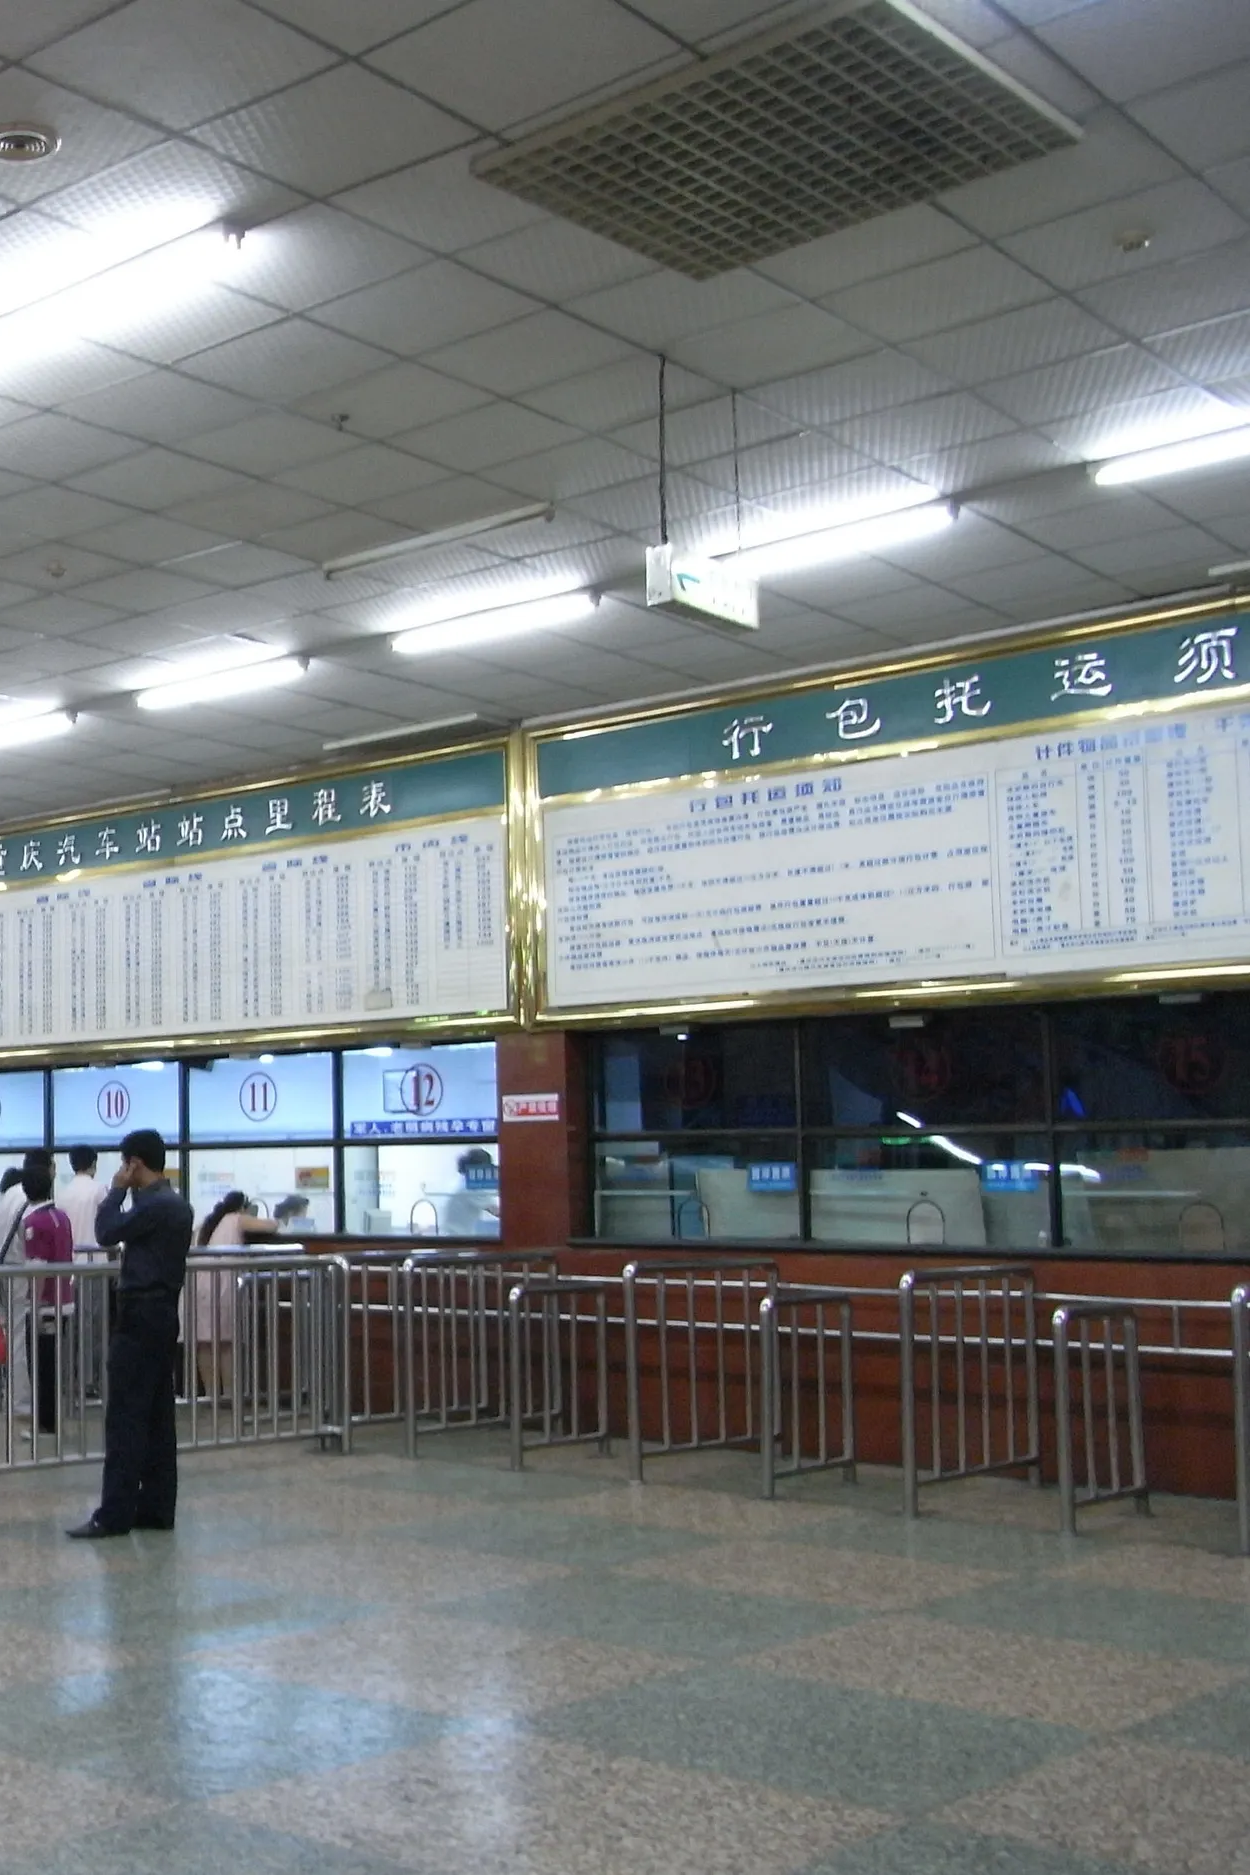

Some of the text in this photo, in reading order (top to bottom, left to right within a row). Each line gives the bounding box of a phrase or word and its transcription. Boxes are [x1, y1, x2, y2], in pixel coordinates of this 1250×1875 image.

[722, 627, 1238, 761] 行包托运须
[105, 1090, 125, 1120] 10
[248, 1079, 271, 1112] 11
[412, 1074, 435, 1107] 12
